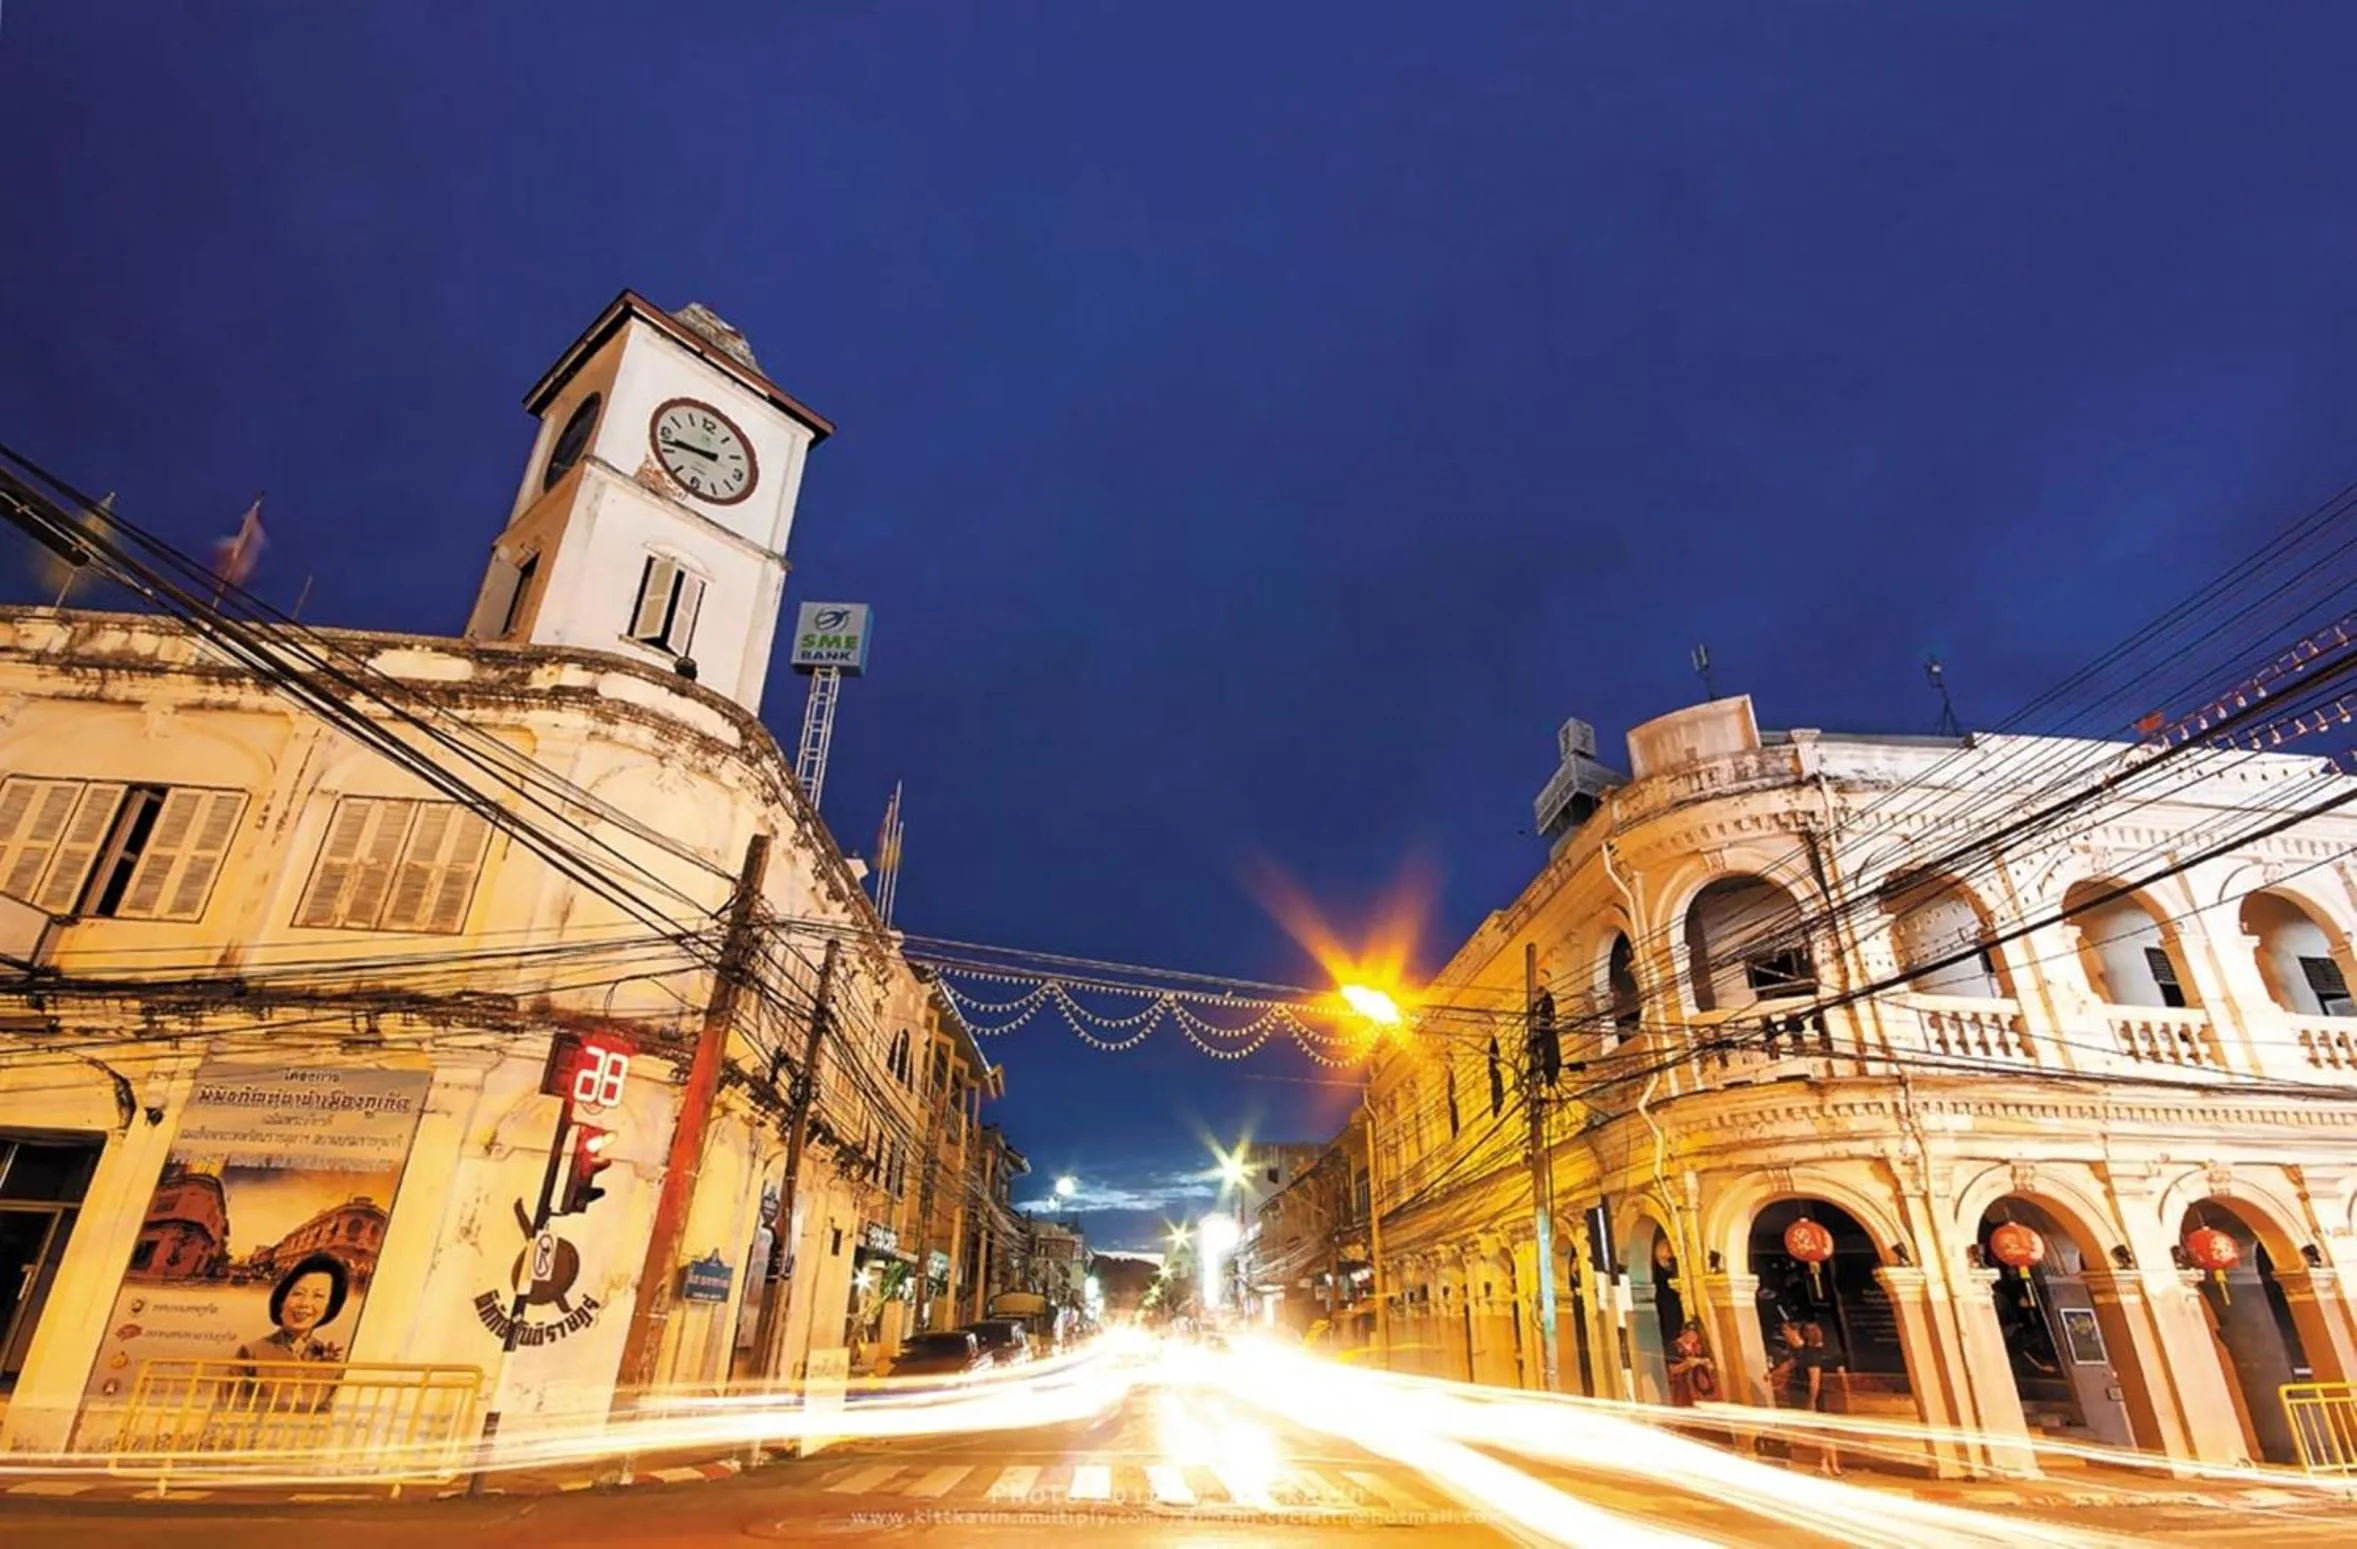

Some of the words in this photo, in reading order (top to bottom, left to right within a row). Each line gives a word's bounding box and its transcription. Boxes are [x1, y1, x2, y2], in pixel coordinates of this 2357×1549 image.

[703, 418, 716, 435] 12
[733, 468, 743, 482] 3
[690, 477, 700, 490] 6
[801, 634, 858, 650] SME
[801, 651, 851, 660] BANK
